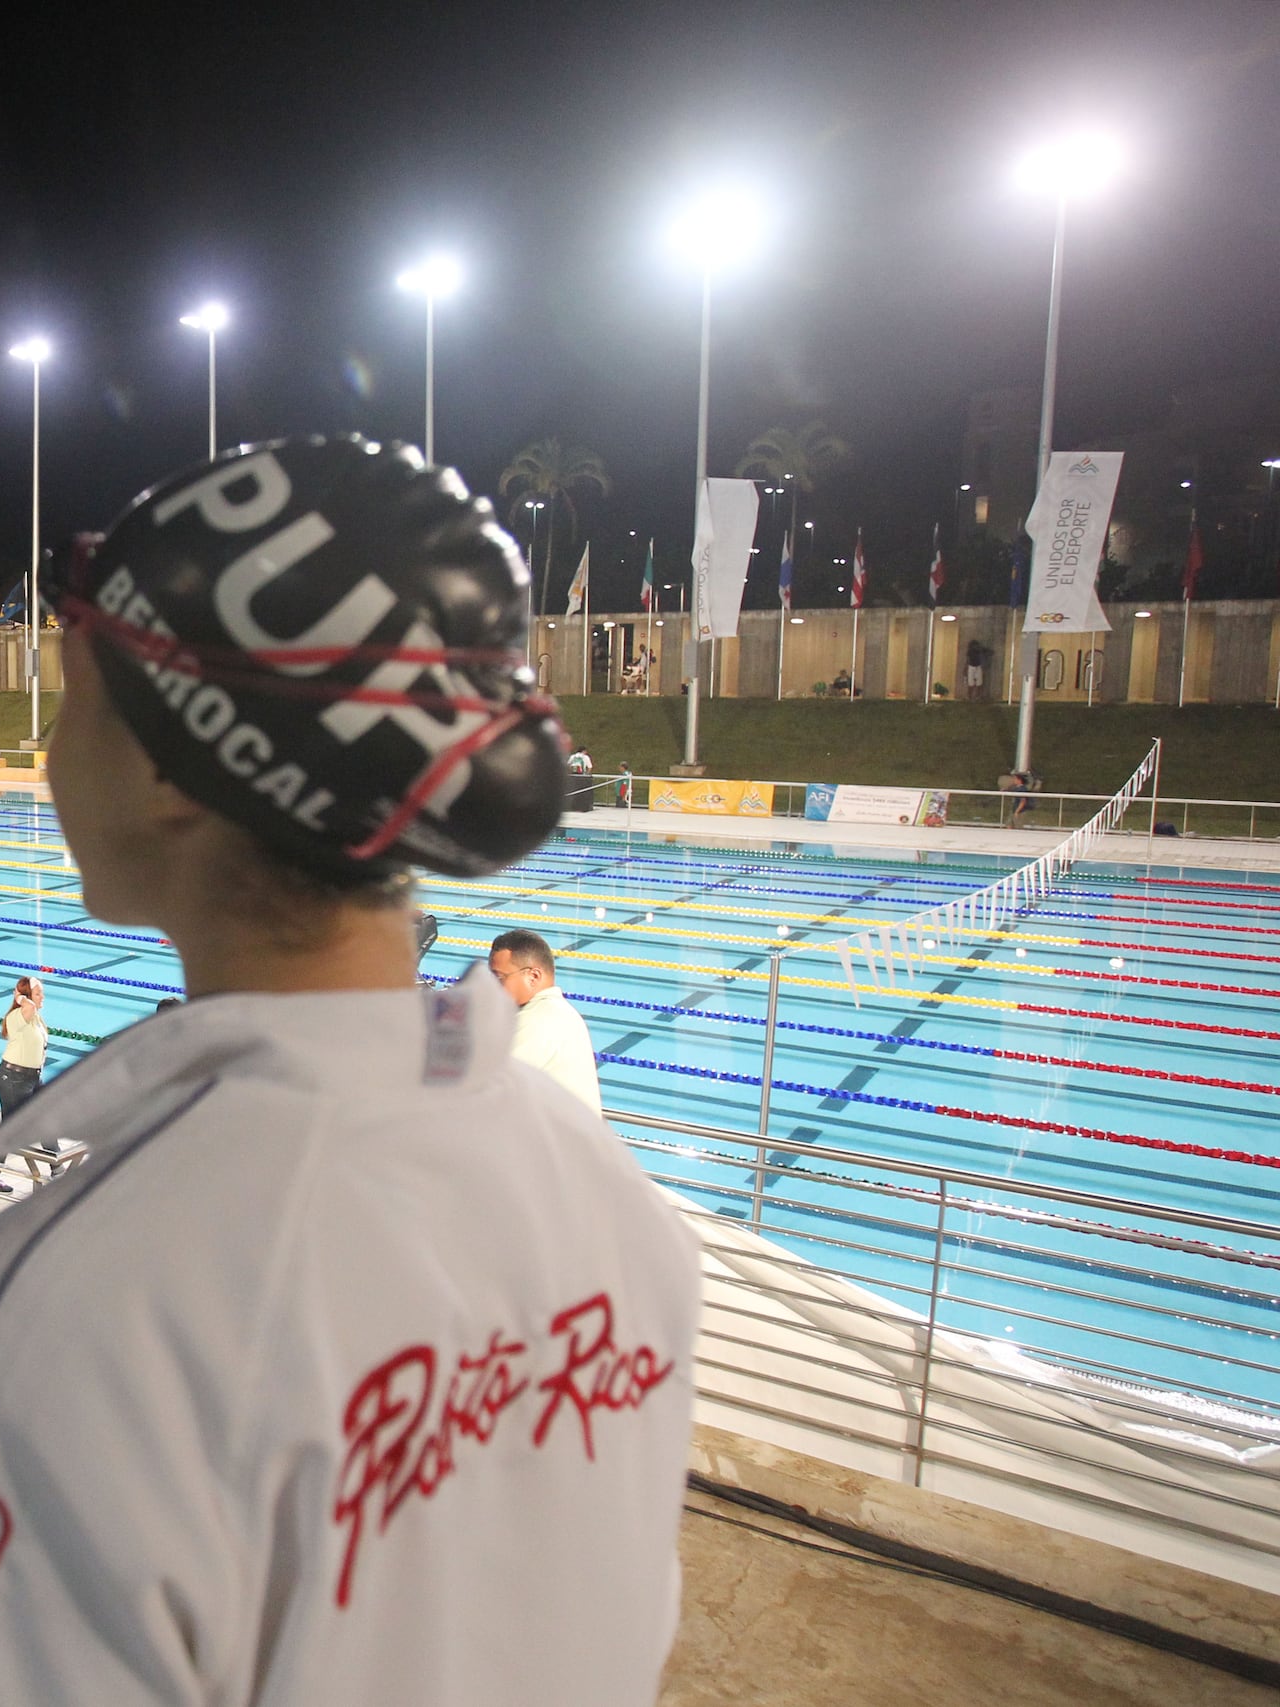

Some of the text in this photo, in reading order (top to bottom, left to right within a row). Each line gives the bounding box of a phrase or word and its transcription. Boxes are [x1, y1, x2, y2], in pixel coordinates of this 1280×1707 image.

[1045, 498, 1074, 589] UNIDOS POR
[1064, 501, 1092, 566] DEPORTE
[1060, 568, 1076, 585] EL
[530, 1291, 676, 1464] Rico
